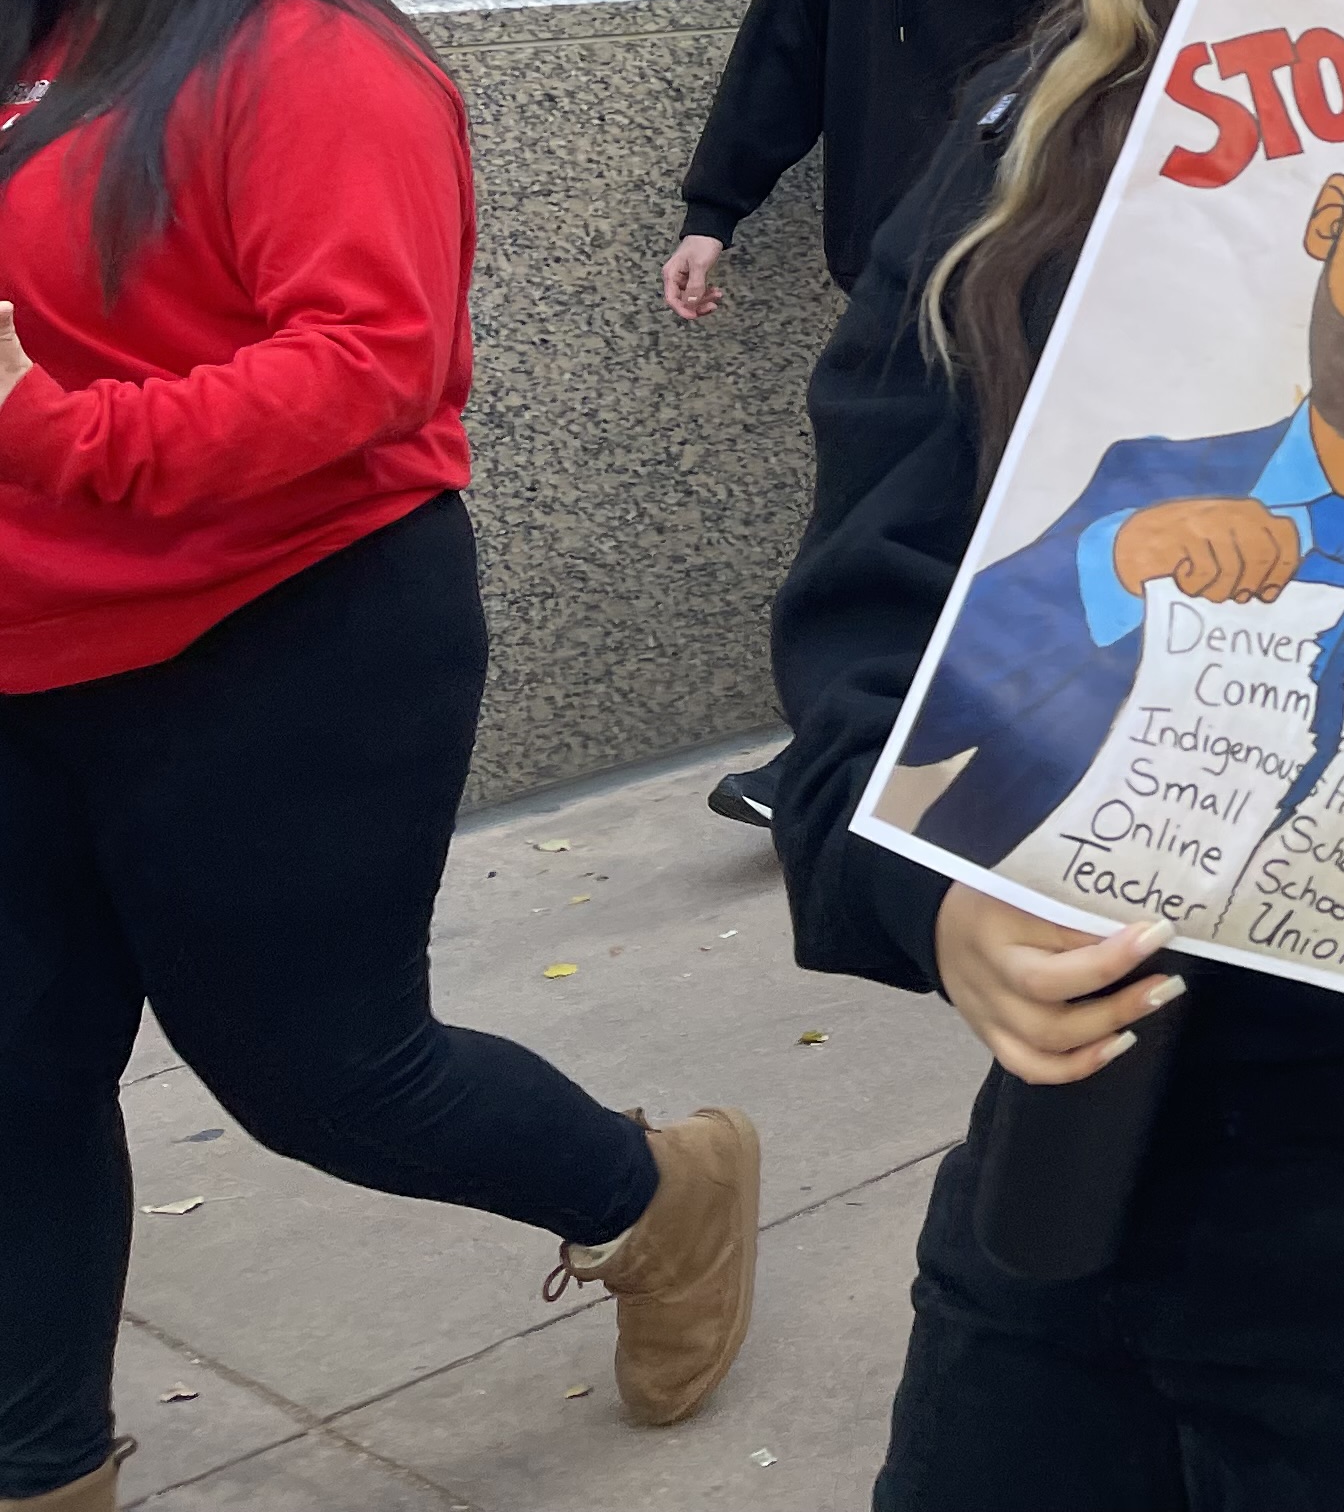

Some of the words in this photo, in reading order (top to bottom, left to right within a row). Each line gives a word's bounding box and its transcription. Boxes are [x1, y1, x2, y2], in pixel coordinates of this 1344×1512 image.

[1166, 601, 1318, 664] Denver
[1195, 663, 1312, 723] Comm
[1129, 706, 1308, 785] Indigenous
[1125, 757, 1253, 824] Small
[1091, 799, 1223, 876] Online
[1059, 832, 1207, 922] Teacher
